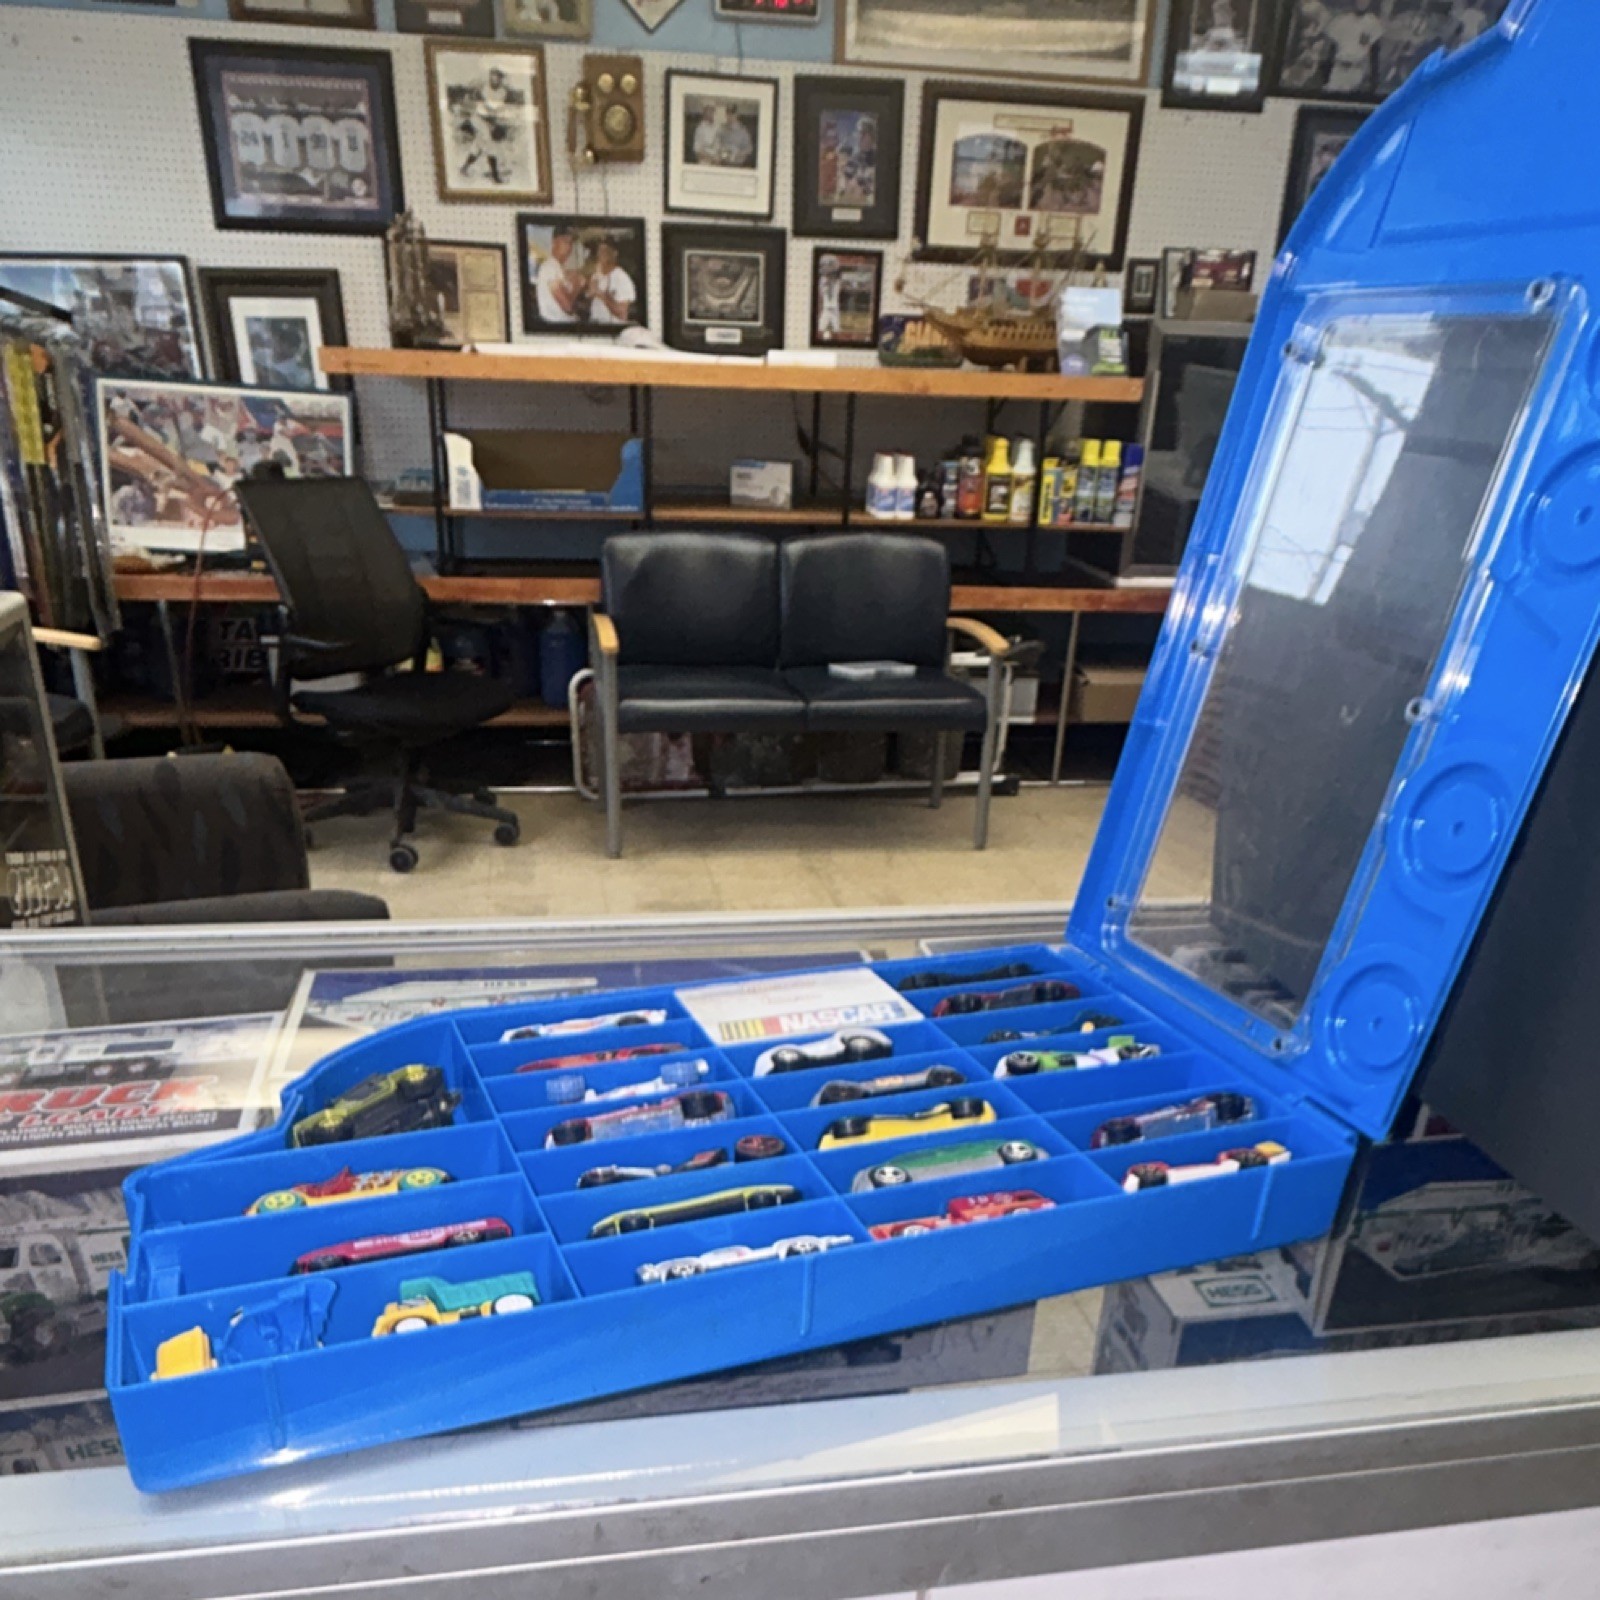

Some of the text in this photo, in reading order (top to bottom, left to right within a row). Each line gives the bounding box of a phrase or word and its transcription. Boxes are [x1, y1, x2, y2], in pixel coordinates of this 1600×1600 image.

[779, 1001, 896, 1034] NASCAR
[1206, 1283, 1263, 1298] HESS
[65, 1437, 121, 1462] HES
